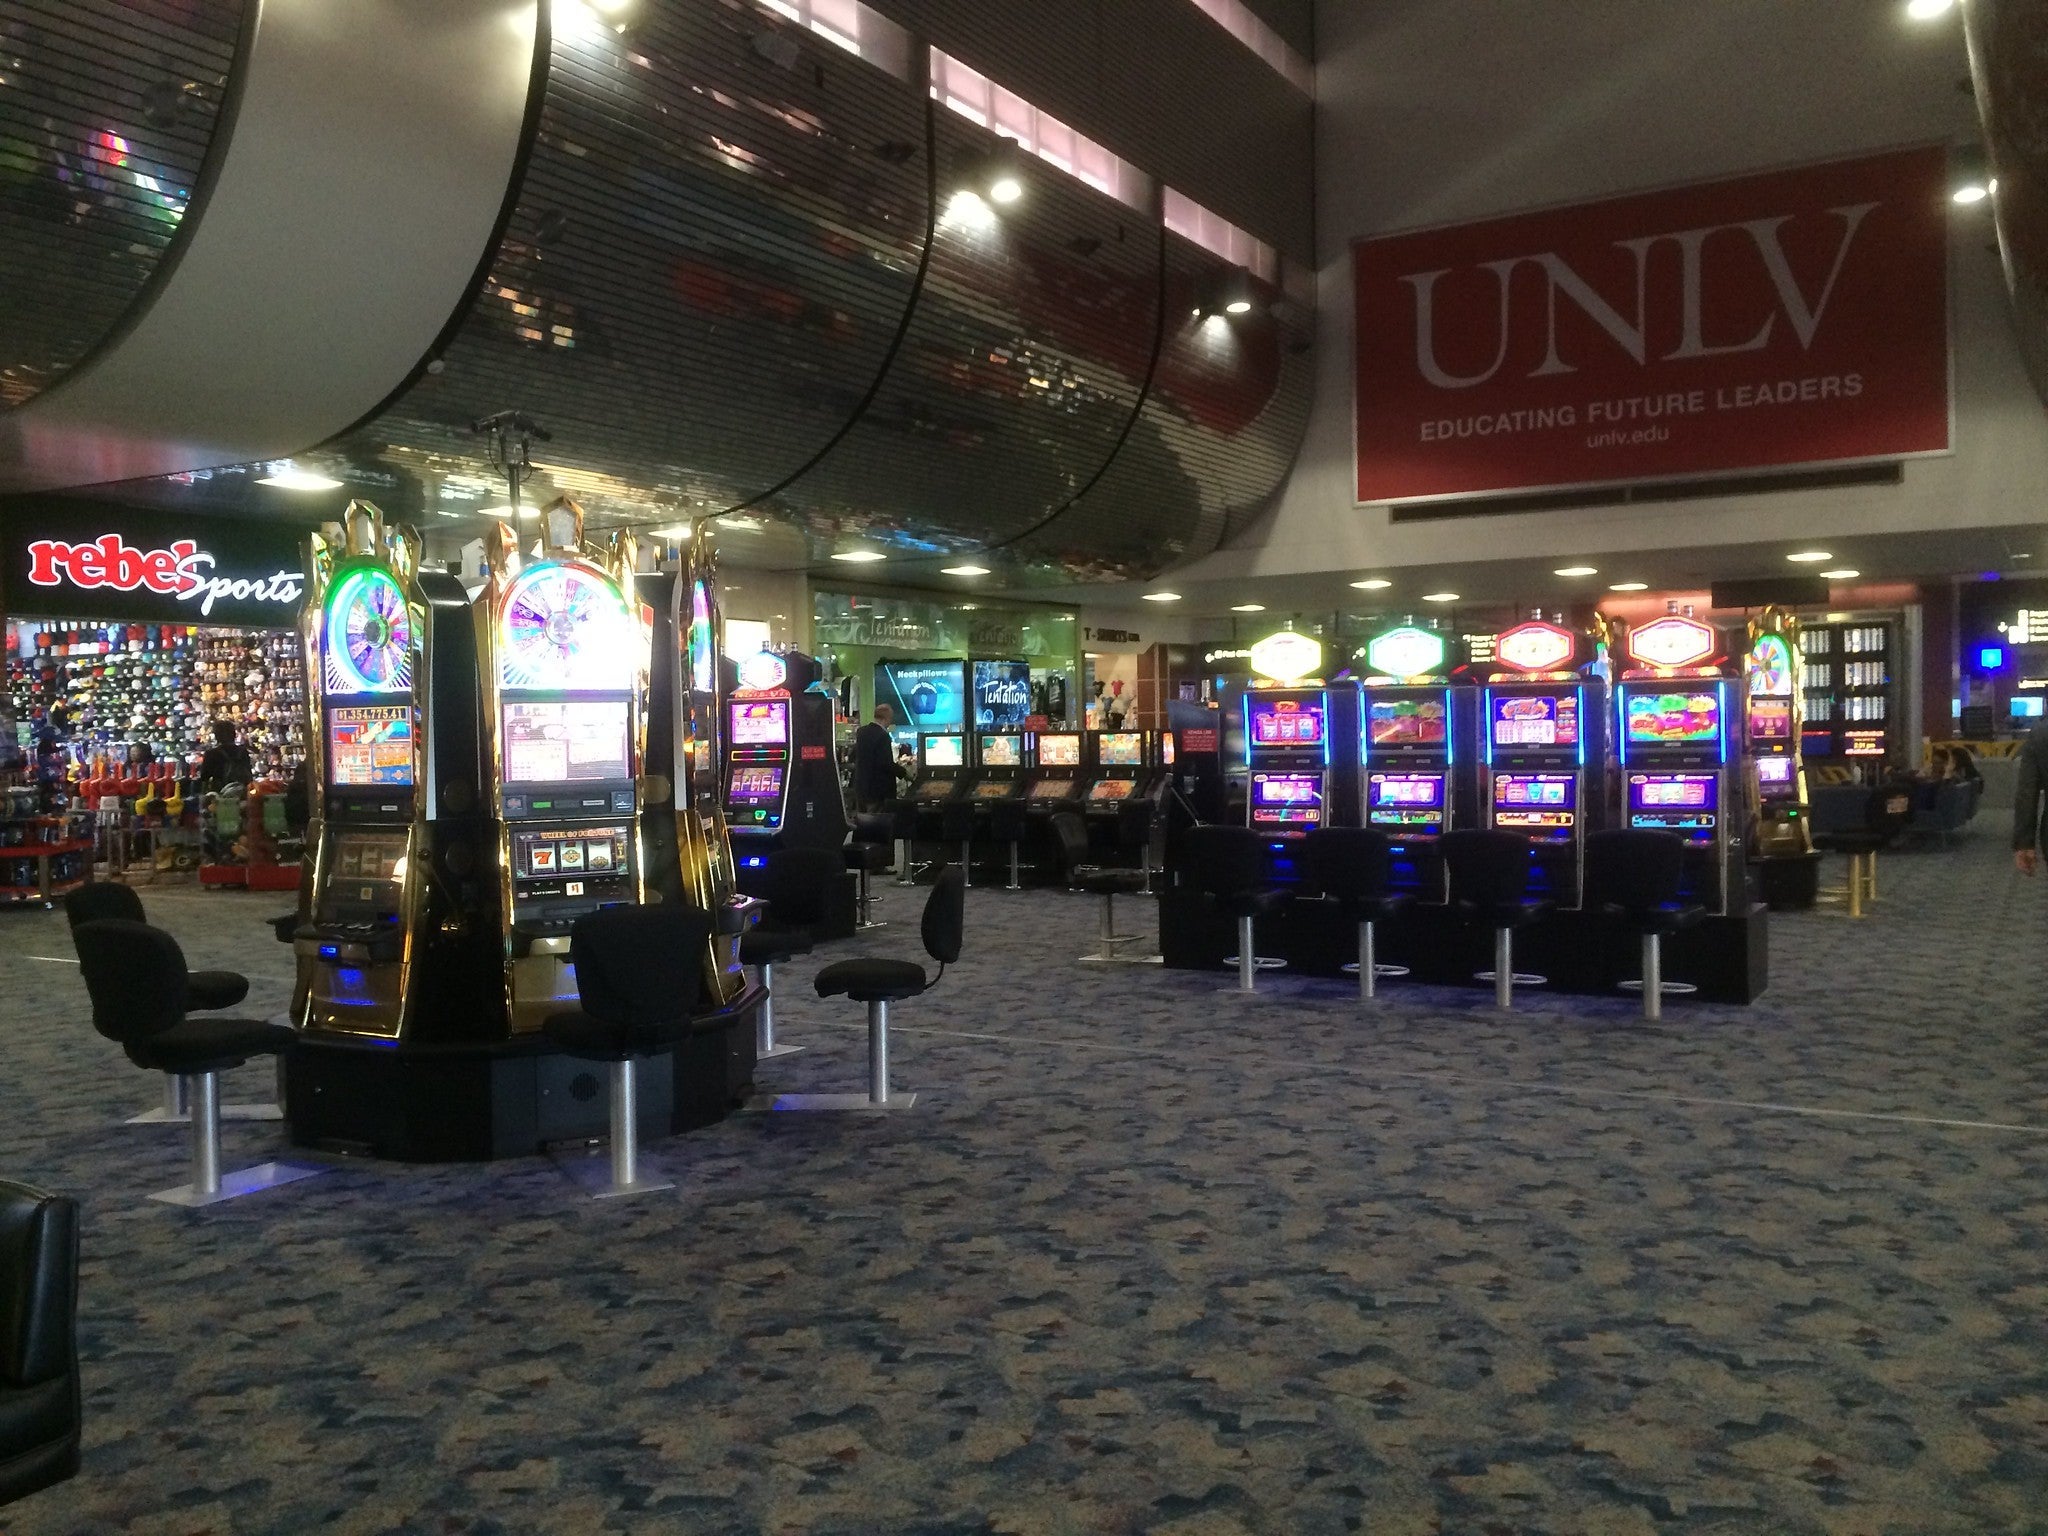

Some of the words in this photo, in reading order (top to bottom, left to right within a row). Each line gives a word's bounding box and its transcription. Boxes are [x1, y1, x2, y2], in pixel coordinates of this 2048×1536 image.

[1398, 201, 1882, 389] UNLV
[1420, 405, 1577, 442] EDUCATING
[1588, 390, 1704, 424] FUTURE
[1717, 373, 1864, 410] LEADERS
[1587, 425, 1669, 448] unlv.edu
[175, 553, 305, 616] Sports
[897, 670, 947, 678] Neckpillows
[983, 680, 1027, 704] Tentation
[571, 883, 579, 893] $1
